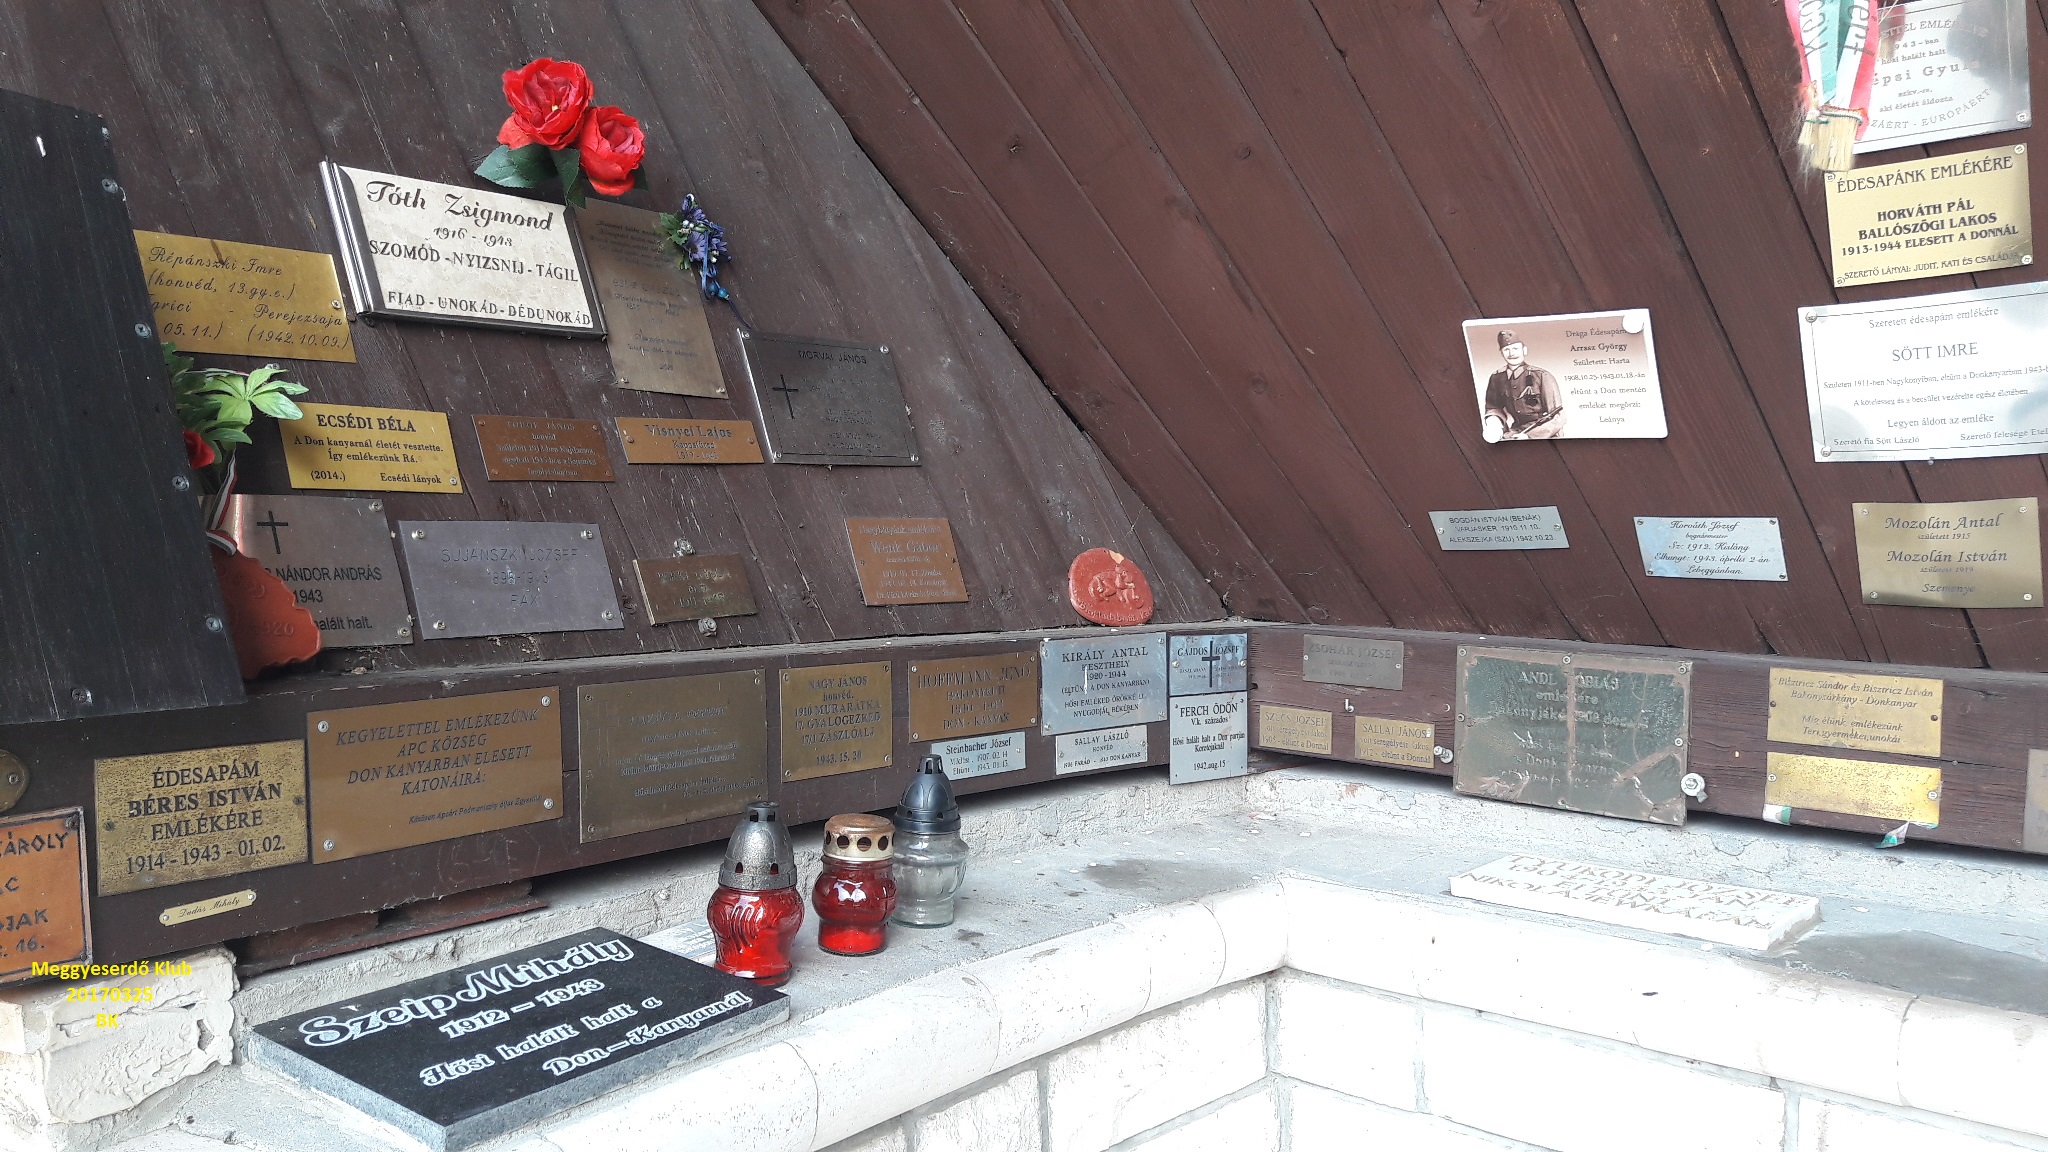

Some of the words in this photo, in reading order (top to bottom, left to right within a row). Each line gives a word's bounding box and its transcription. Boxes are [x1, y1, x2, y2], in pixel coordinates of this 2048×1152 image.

[1836, 168, 1927, 193] ÉDESAPÁNK
[1930, 155, 2014, 180] EMLÉKÉRE
[366, 180, 426, 210] Tóth
[444, 193, 554, 232] Zsigmond
[1876, 203, 1943, 222] HORVÁTH
[1946, 198, 1975, 213] PÁL
[1858, 216, 1945, 240] BALLÓSZÖGI
[1949, 212, 1998, 229] LAKOS
[1841, 239, 1902, 256] 1913-1944
[1904, 233, 1954, 249] ELESETT
[1957, 231, 1967, 242] A
[1969, 224, 2019, 240] DONNÁL
[148, 246, 237, 271] Répánszki
[241, 258, 282, 276] Imre
[369, 239, 441, 263] SZOMÓD
[536, 263, 578, 282] TÁGIL
[1961, 256, 1973, 266] ÉS
[148, 268, 217, 293] (honvéd,
[387, 291, 425, 306] FIAD
[438, 296, 498, 315] UNOKÁD
[1597, 342, 1628, 353] György
[1891, 345, 1931, 362] SÖTT
[1937, 342, 1979, 358] IMRE
[316, 412, 373, 430] ECSÉDI
[378, 416, 417, 433] BÉLA
[294, 435, 302, 445] A
[304, 435, 324, 446] Don
[327, 436, 373, 449] kanyarnál
[375, 440, 401, 450] életét
[328, 448, 343, 462] Így
[310, 470, 346, 482] (2014.)
[380, 472, 411, 483] Ecsédi
[413, 473, 442, 485] lányok
[1884, 516, 1951, 530] Mozolán
[1952, 513, 2004, 531] Antal
[1952, 532, 1971, 540] 1915
[1886, 549, 1952, 563] Mozolán
[1956, 549, 2008, 563] István
[334, 564, 383, 581] ANDRÁS
[314, 616, 345, 631] alált
[347, 615, 373, 630] halt.
[1061, 649, 1105, 663] KIRÁLY
[1111, 646, 1149, 659] ANTAL
[837, 674, 868, 689] JÁNOS
[1179, 705, 1209, 718] FERCH
[335, 719, 441, 746] KEGYELETTEL
[445, 707, 540, 733] EMLÉKEZÜNK
[1103, 729, 1129, 742] LÁSZLÓ
[396, 741, 427, 758] APC
[430, 731, 488, 754] KÖZSÉG
[945, 741, 988, 755] Steinbacher
[151, 759, 261, 788] ÉDESAPÁM
[346, 766, 383, 785] DON
[384, 754, 471, 779] KANYARBAN
[475, 744, 533, 765] ELESETT
[127, 793, 200, 818] BÉRES
[208, 780, 283, 808] ISTVÁN
[151, 808, 263, 841] EMLÉKÉRE
[127, 853, 165, 875] 1914
[182, 844, 221, 866] 1943
[299, 993, 458, 1048] Szeip
[455, 938, 635, 1002] Mihály
[439, 1008, 511, 1039] 1912
[535, 978, 605, 1009] 1943
[419, 1052, 496, 1087] Hősi
[495, 1022, 580, 1061] halált
[579, 1002, 639, 1032] halt
[641, 996, 663, 1010] a
